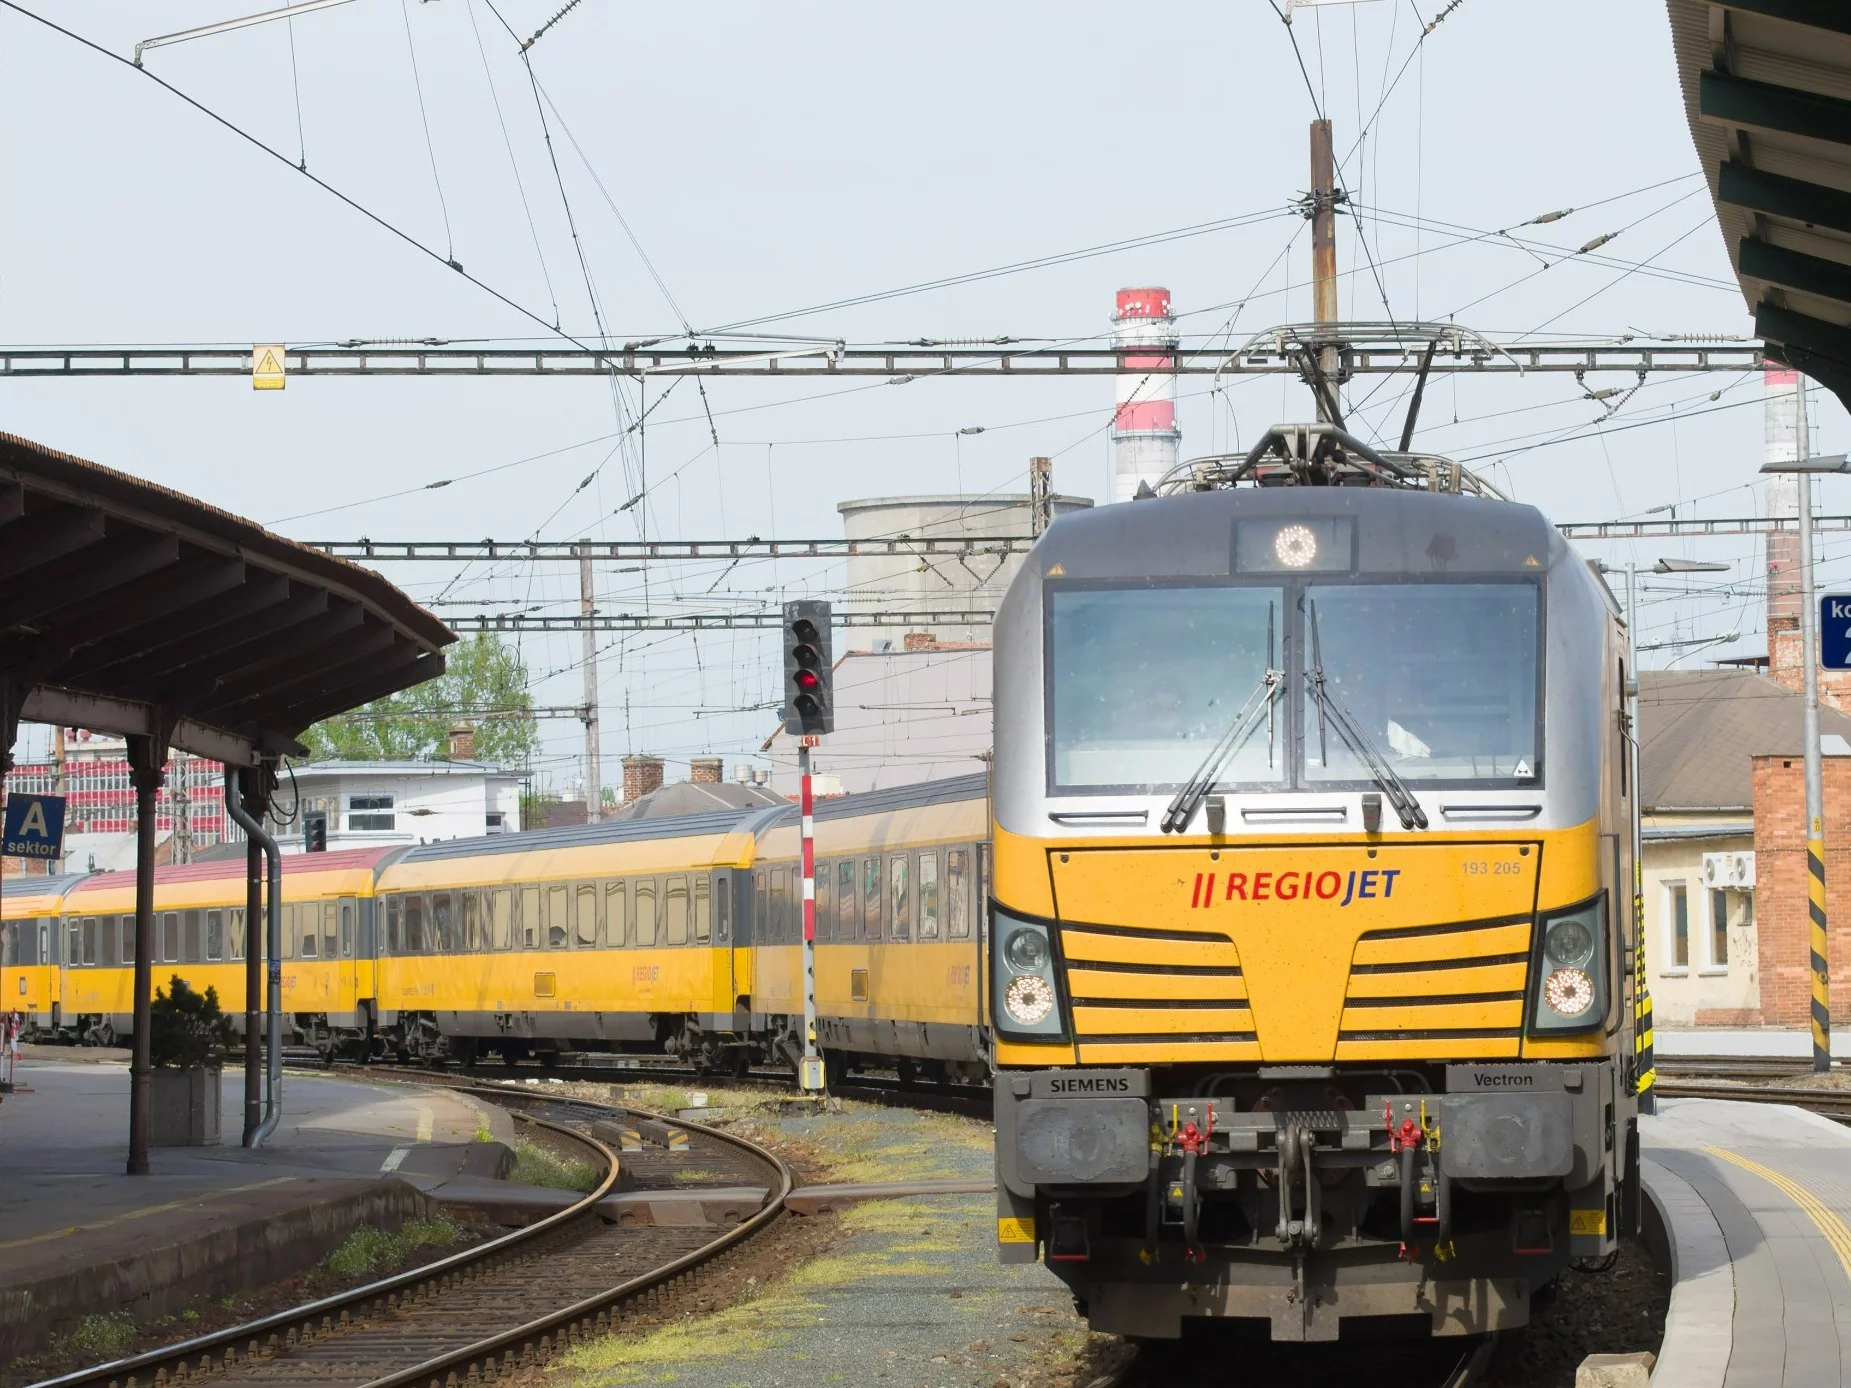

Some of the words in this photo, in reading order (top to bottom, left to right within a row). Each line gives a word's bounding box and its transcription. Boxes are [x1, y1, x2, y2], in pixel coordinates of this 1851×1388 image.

[18, 801, 49, 838] A
[7, 840, 57, 856] sektor
[1462, 861, 1488, 875] 193
[1493, 861, 1521, 875] 205
[1225, 869, 1401, 907] REGIOJET
[1050, 1078, 1129, 1093] SIEMENS
[1473, 1073, 1533, 1087] Vectron
